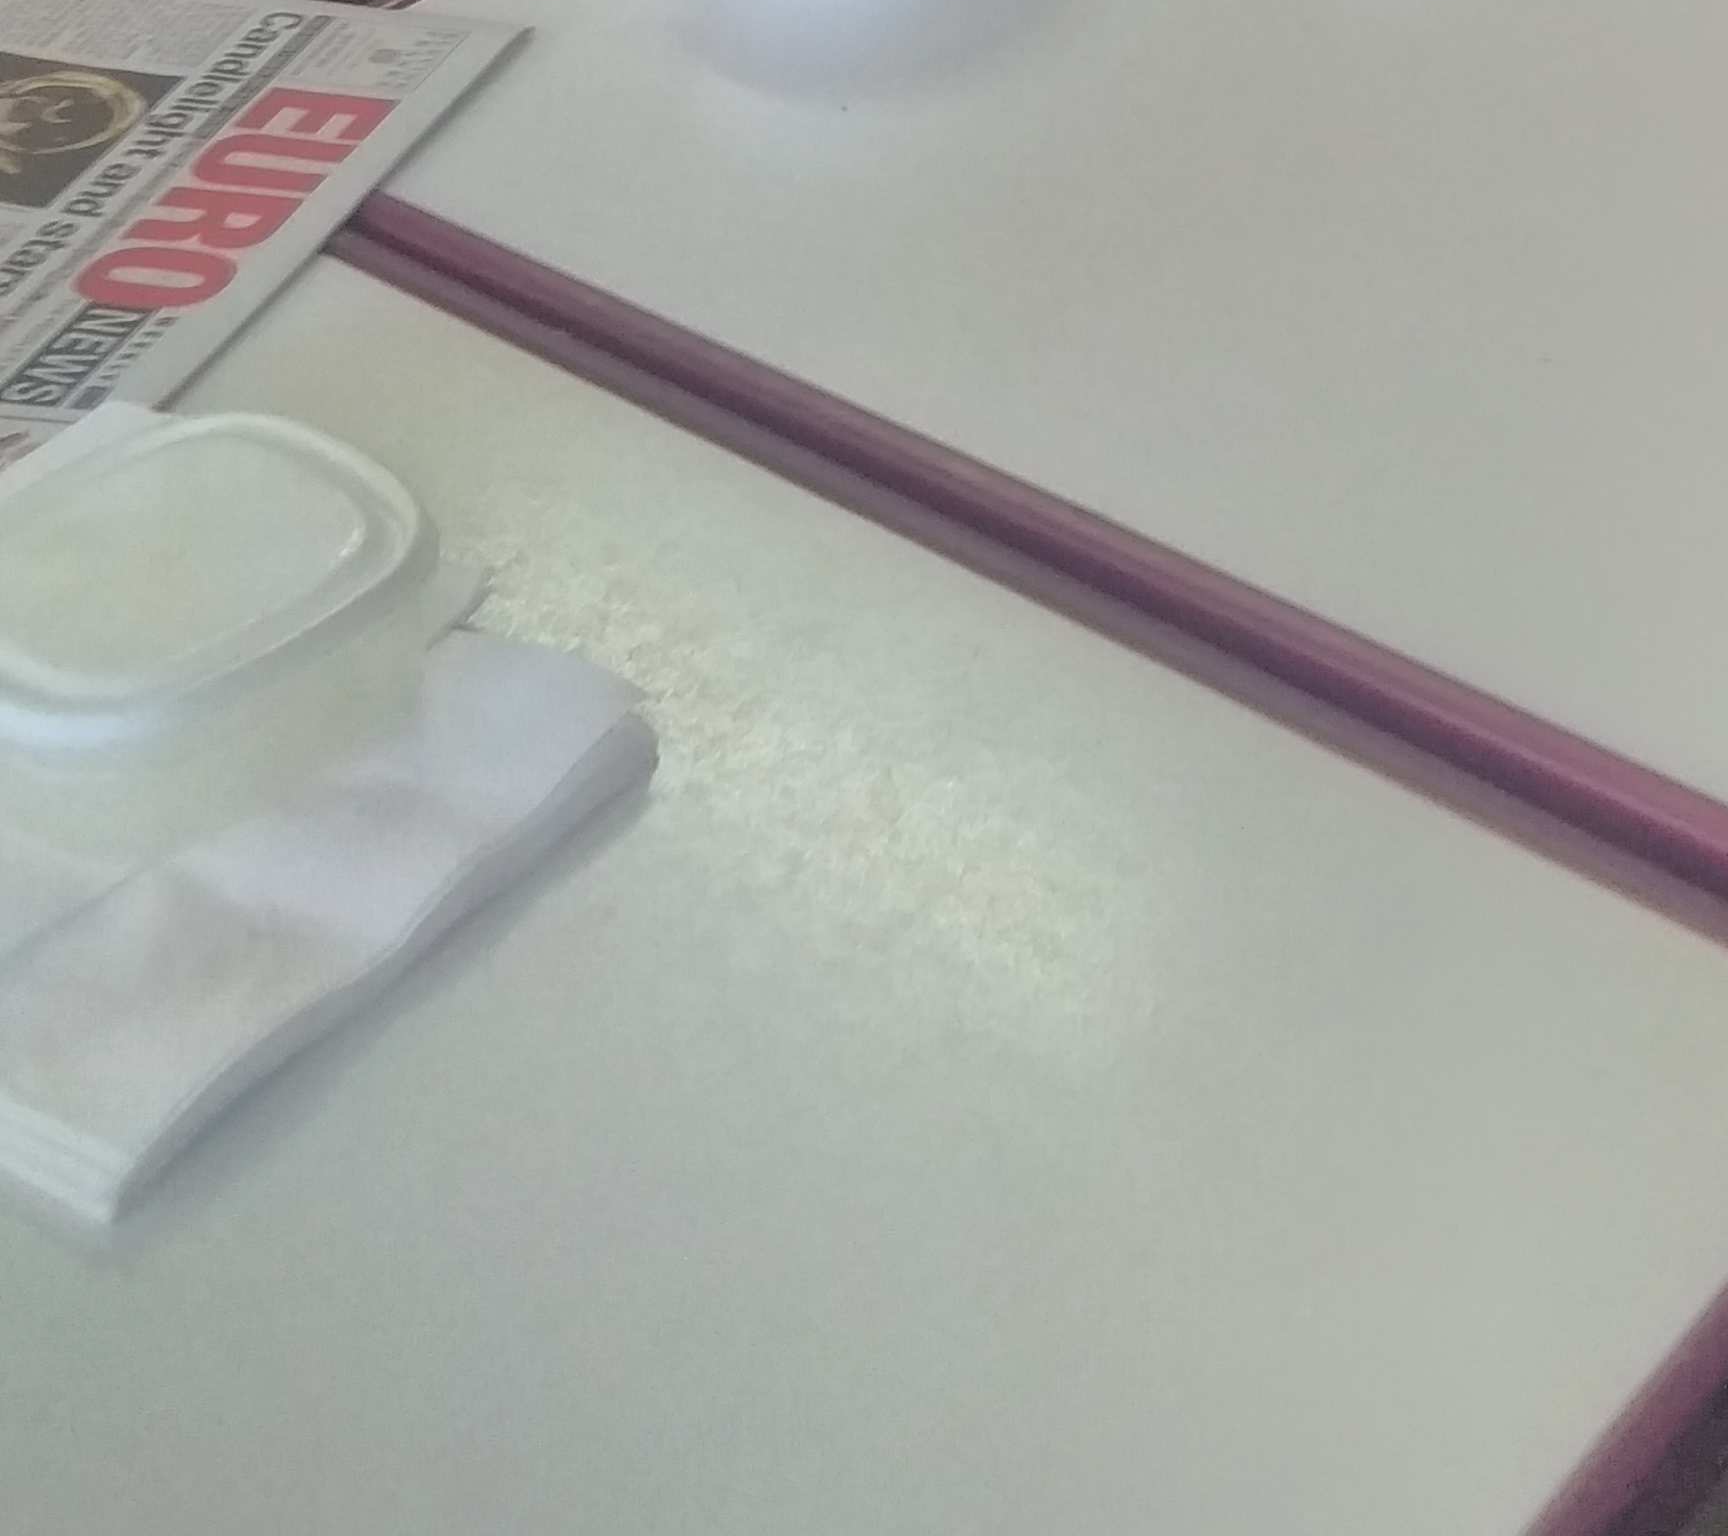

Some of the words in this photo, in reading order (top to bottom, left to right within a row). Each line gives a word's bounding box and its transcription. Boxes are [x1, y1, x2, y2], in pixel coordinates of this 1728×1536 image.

[124, 11, 304, 159] Candlelight
[60, 162, 142, 216] and
[73, 86, 401, 309] EURO
[1, 308, 144, 404] NEWS
